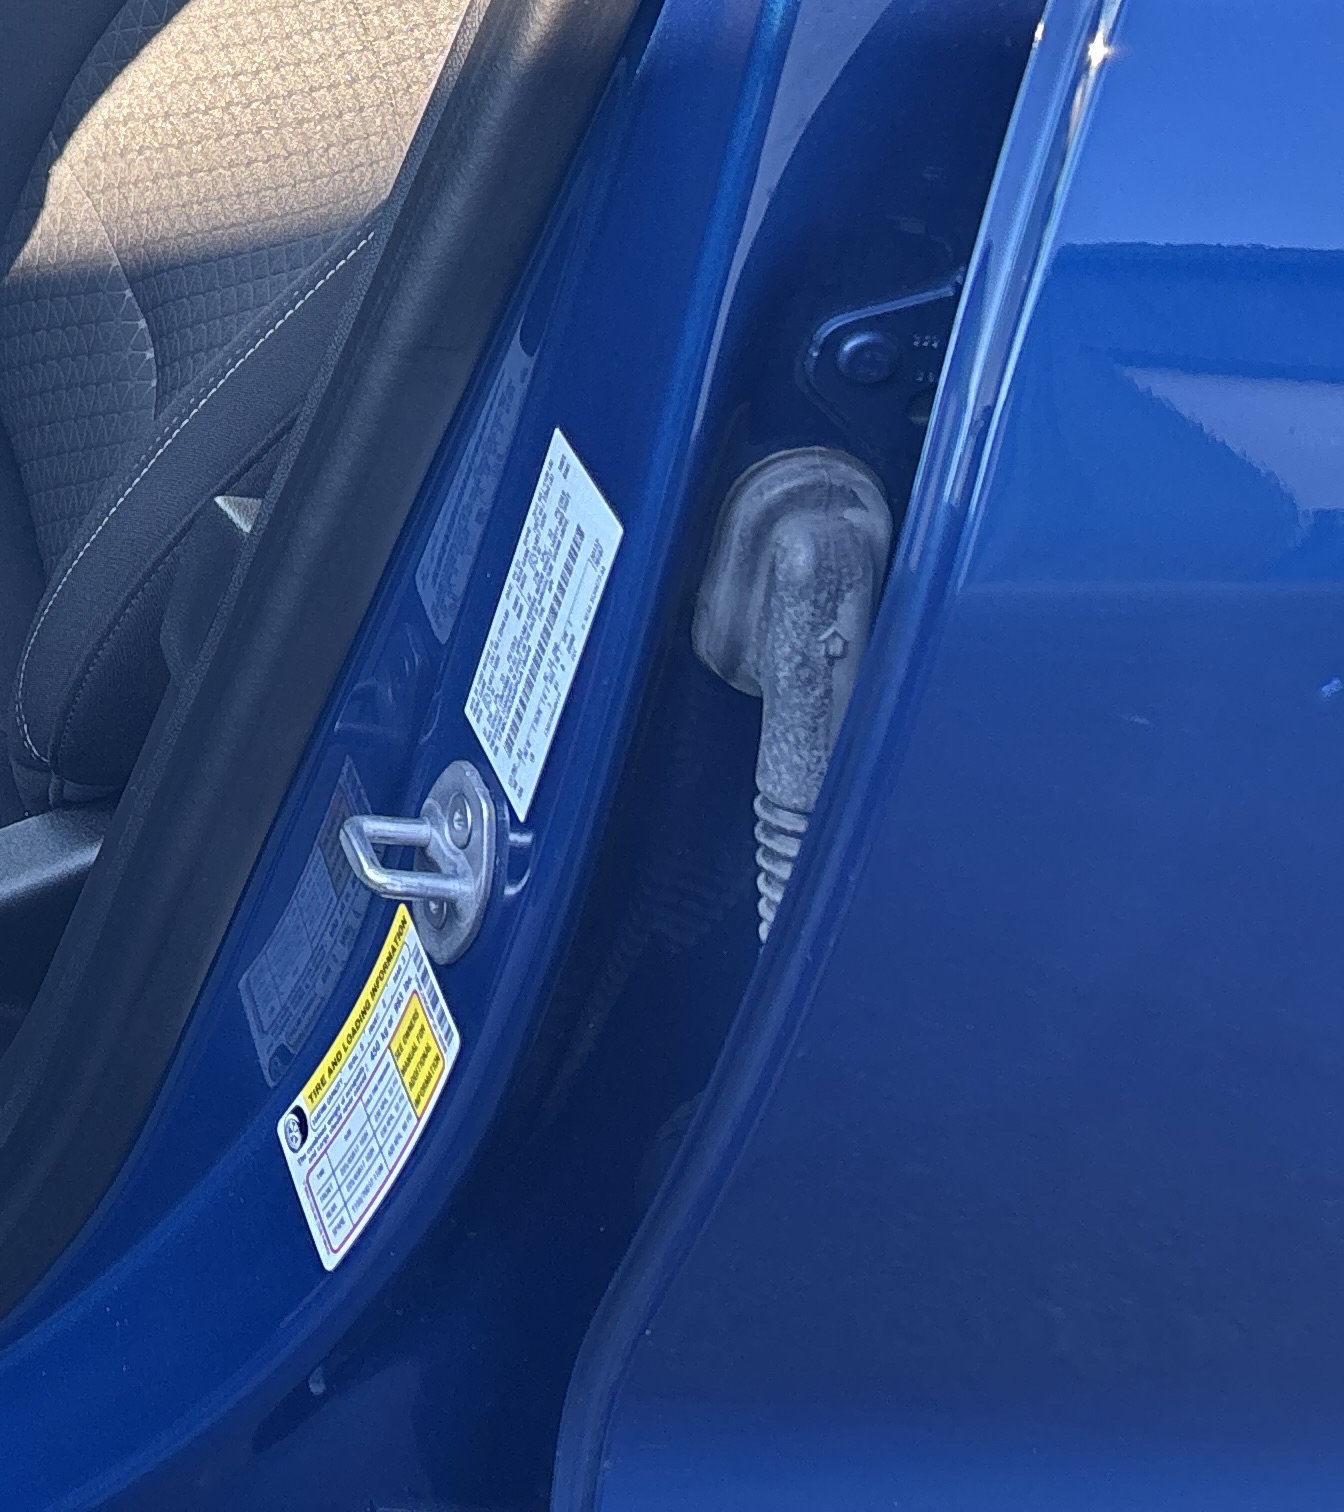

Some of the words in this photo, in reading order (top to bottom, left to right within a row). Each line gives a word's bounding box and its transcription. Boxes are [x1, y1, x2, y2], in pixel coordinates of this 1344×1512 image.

[308, 1074, 326, 1106] TIRE
[326, 1048, 342, 1078] AND
[342, 999, 371, 1053] LOADING
[369, 915, 407, 999] INFORMATION
